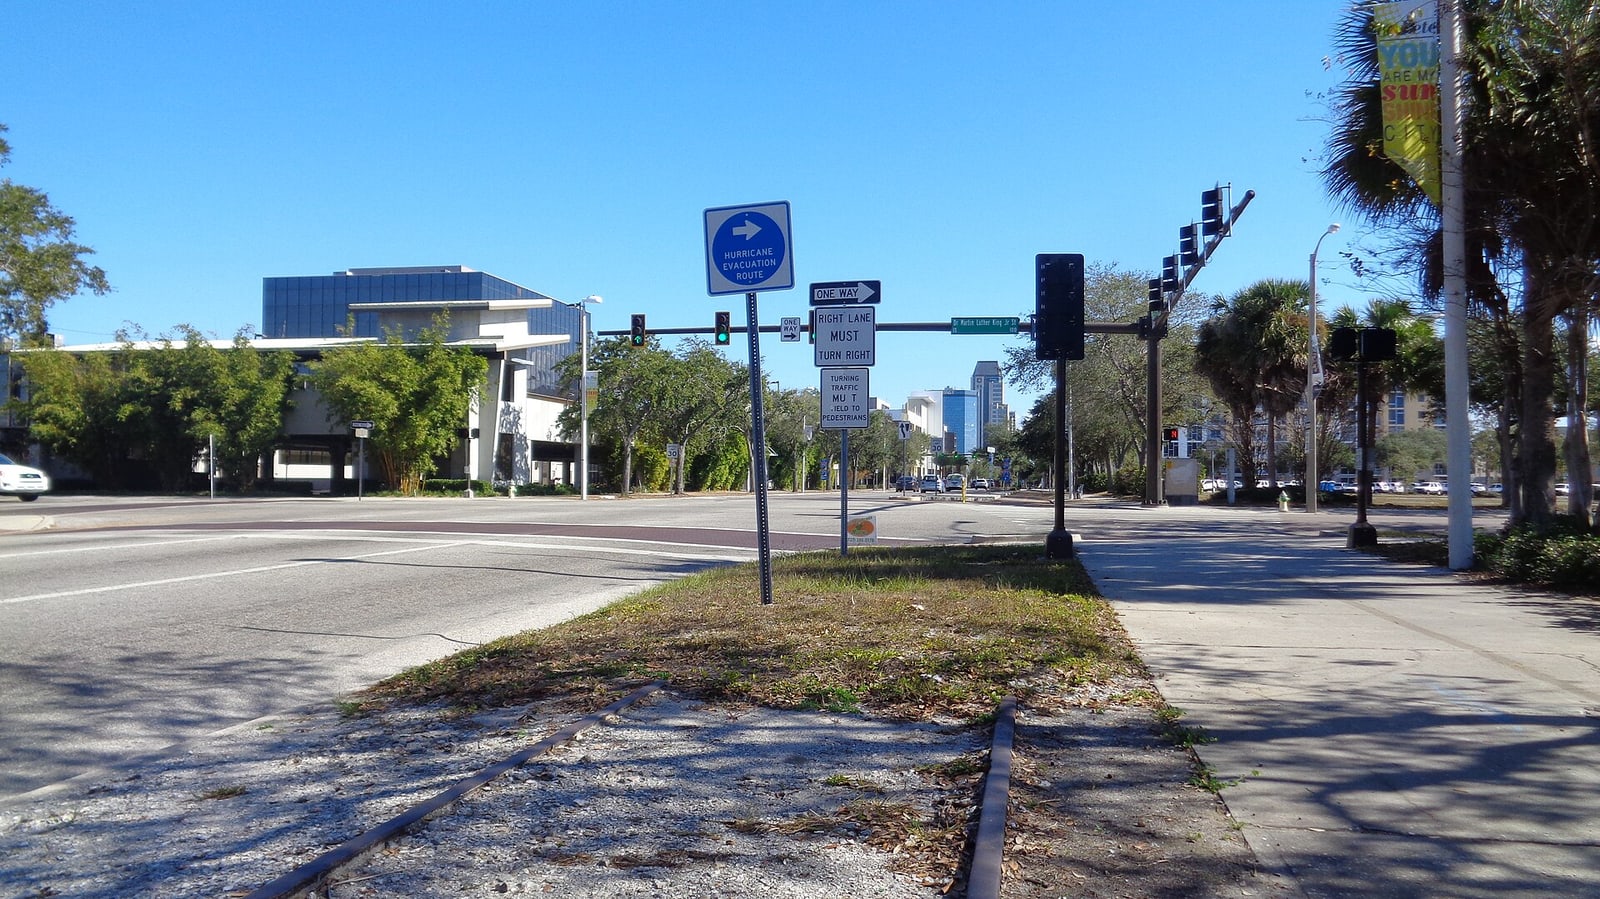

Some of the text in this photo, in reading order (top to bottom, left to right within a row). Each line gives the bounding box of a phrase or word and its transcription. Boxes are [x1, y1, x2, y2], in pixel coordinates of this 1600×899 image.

[1380, 41, 1437, 69] YOU
[1383, 70, 1411, 82] ARE
[1382, 83, 1437, 101] sun
[1384, 124, 1438, 142] CITY
[724, 248, 774, 259] HURRICANE
[723, 258, 776, 271] EVACUATION
[736, 270, 764, 280] ROUTE
[816, 288, 859, 299] ONE WAY
[818, 313, 871, 323] RIGHT LANE
[830, 330, 859, 342] MUST
[818, 350, 871, 360] TURN RIGHT
[832, 393, 857, 402] MUT
